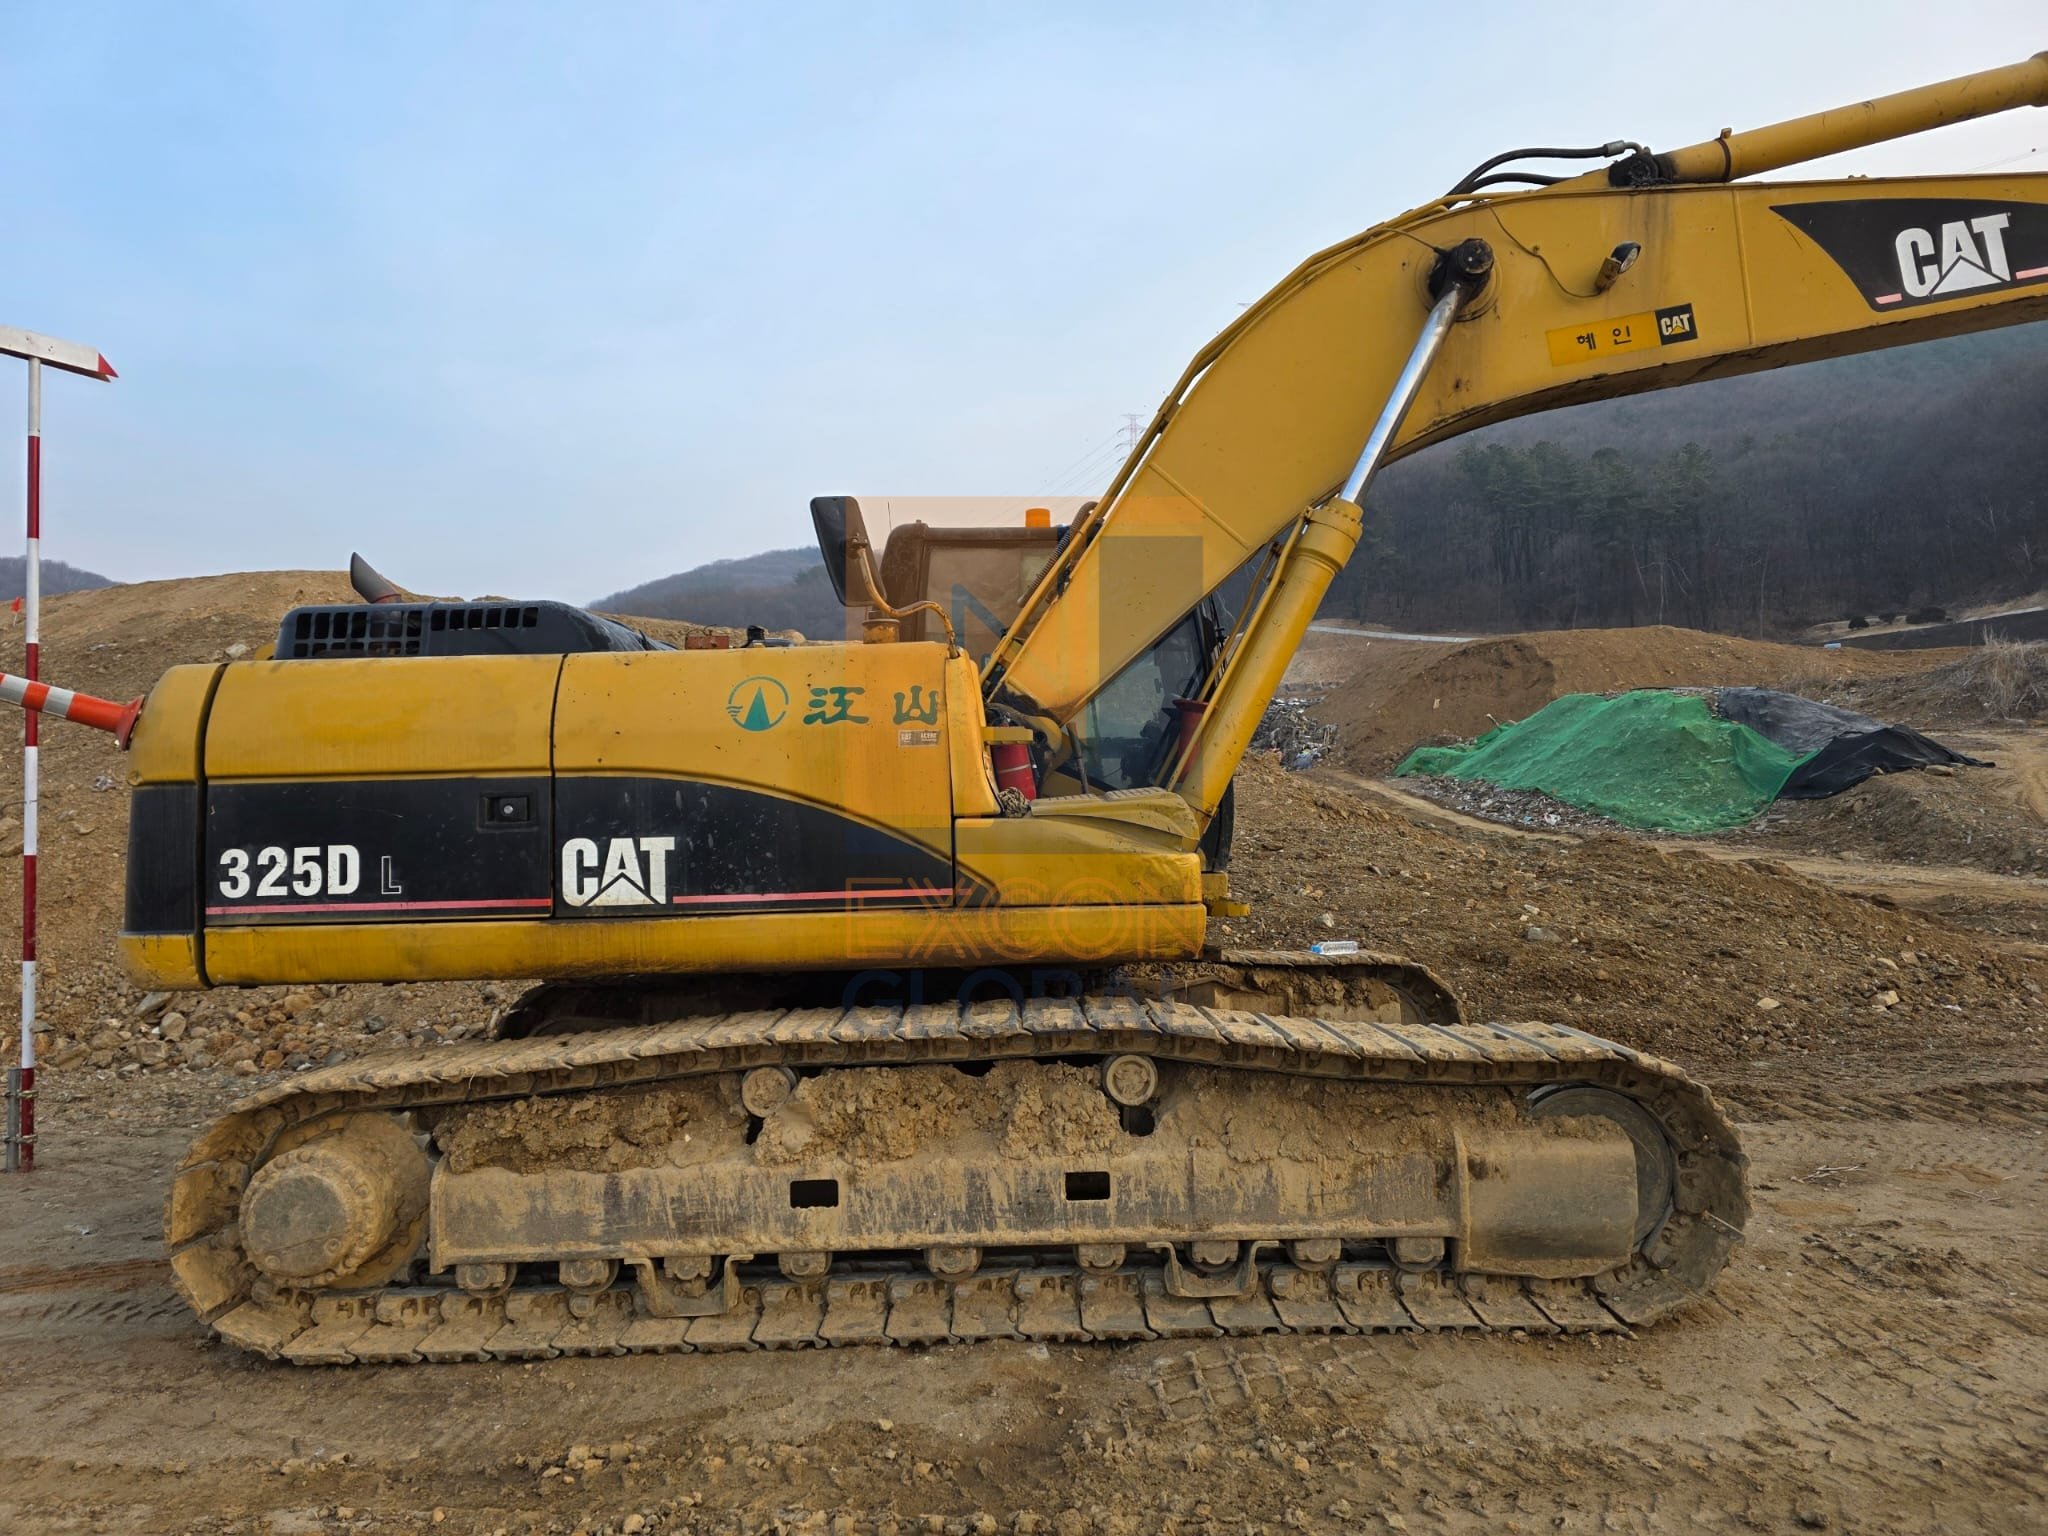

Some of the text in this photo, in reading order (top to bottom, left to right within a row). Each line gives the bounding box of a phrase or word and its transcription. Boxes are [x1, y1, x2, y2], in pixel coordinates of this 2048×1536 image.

[1895, 212, 2012, 298] CAT
[1660, 313, 1691, 336] CAT
[219, 844, 402, 899] 325D L
[562, 836, 675, 907] CAT
